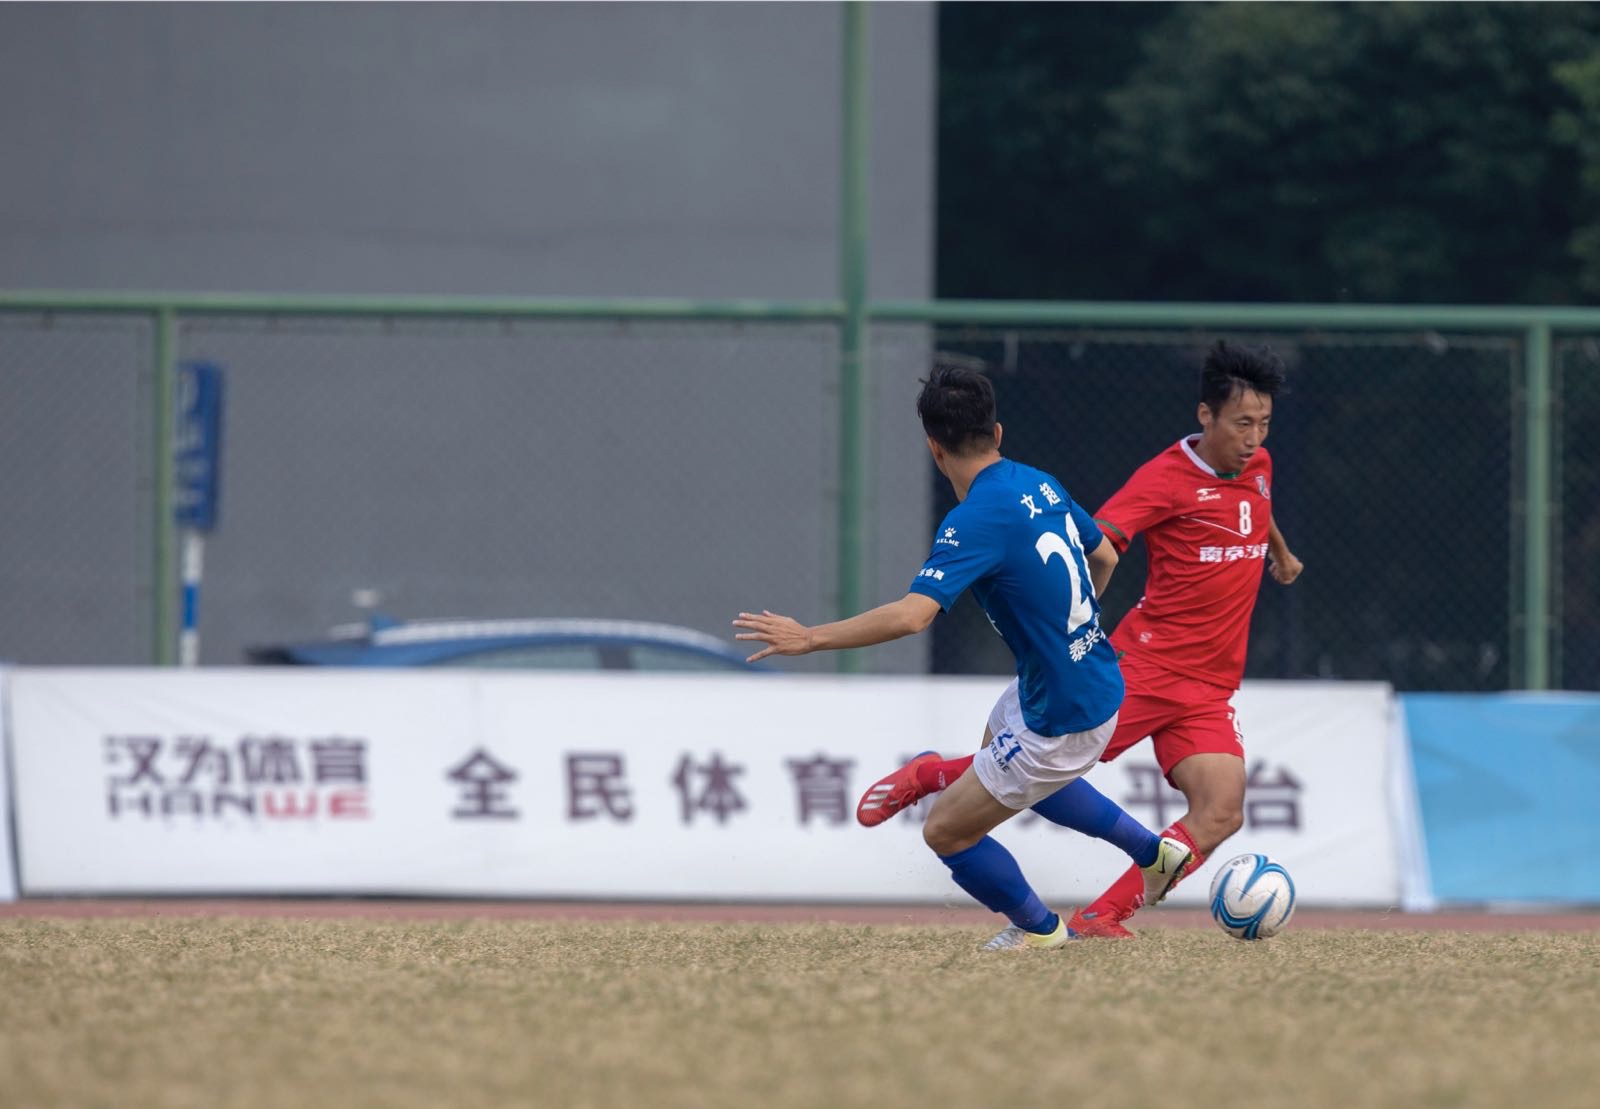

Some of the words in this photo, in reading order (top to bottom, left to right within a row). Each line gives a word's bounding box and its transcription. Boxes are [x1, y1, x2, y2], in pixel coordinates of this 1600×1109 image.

[1239, 501, 1252, 535] 8
[1068, 627, 1106, 662] 泰兴
[105, 735, 369, 785] 汉为体育
[108, 790, 371, 819] HANWE
